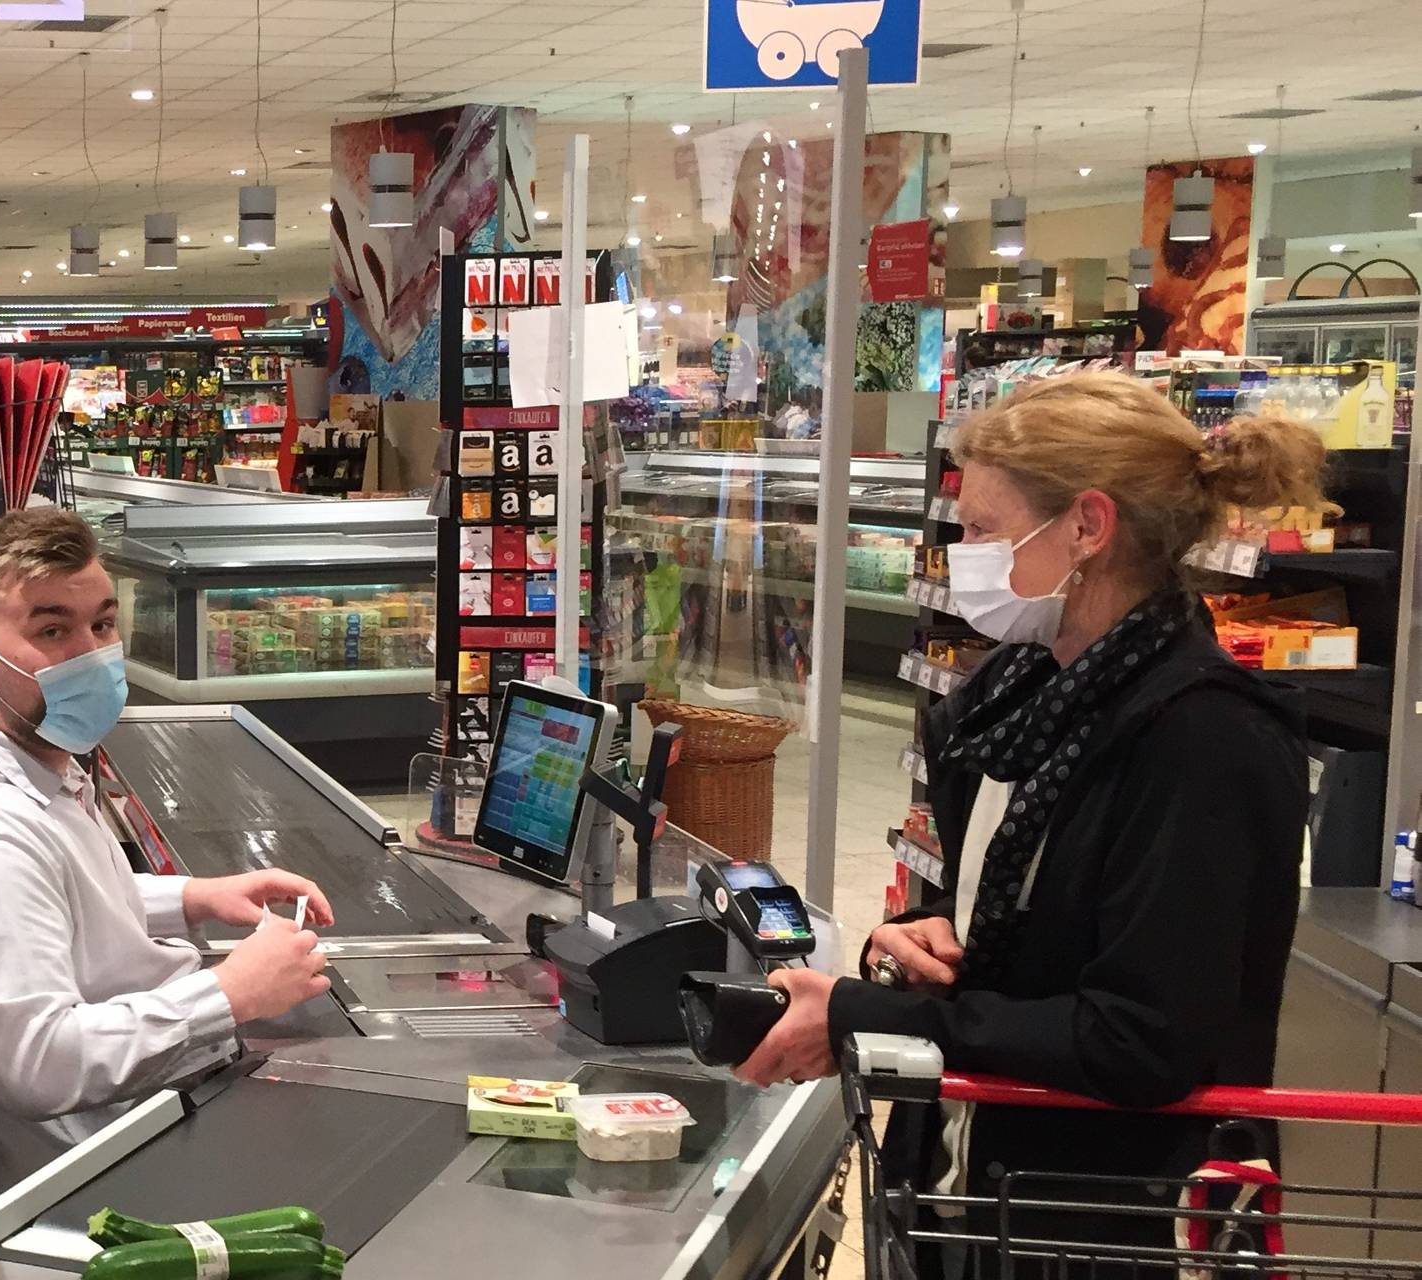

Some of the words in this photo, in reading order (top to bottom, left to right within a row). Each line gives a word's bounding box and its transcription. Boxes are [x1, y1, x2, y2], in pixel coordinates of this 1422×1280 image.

[468, 274, 491, 303] N
[503, 274, 526, 303] N
[536, 275, 560, 304] N
[206, 312, 246, 322] Textilien
[508, 411, 551, 425] EINKAUFEN
[504, 631, 547, 644] EINKAUFEN
